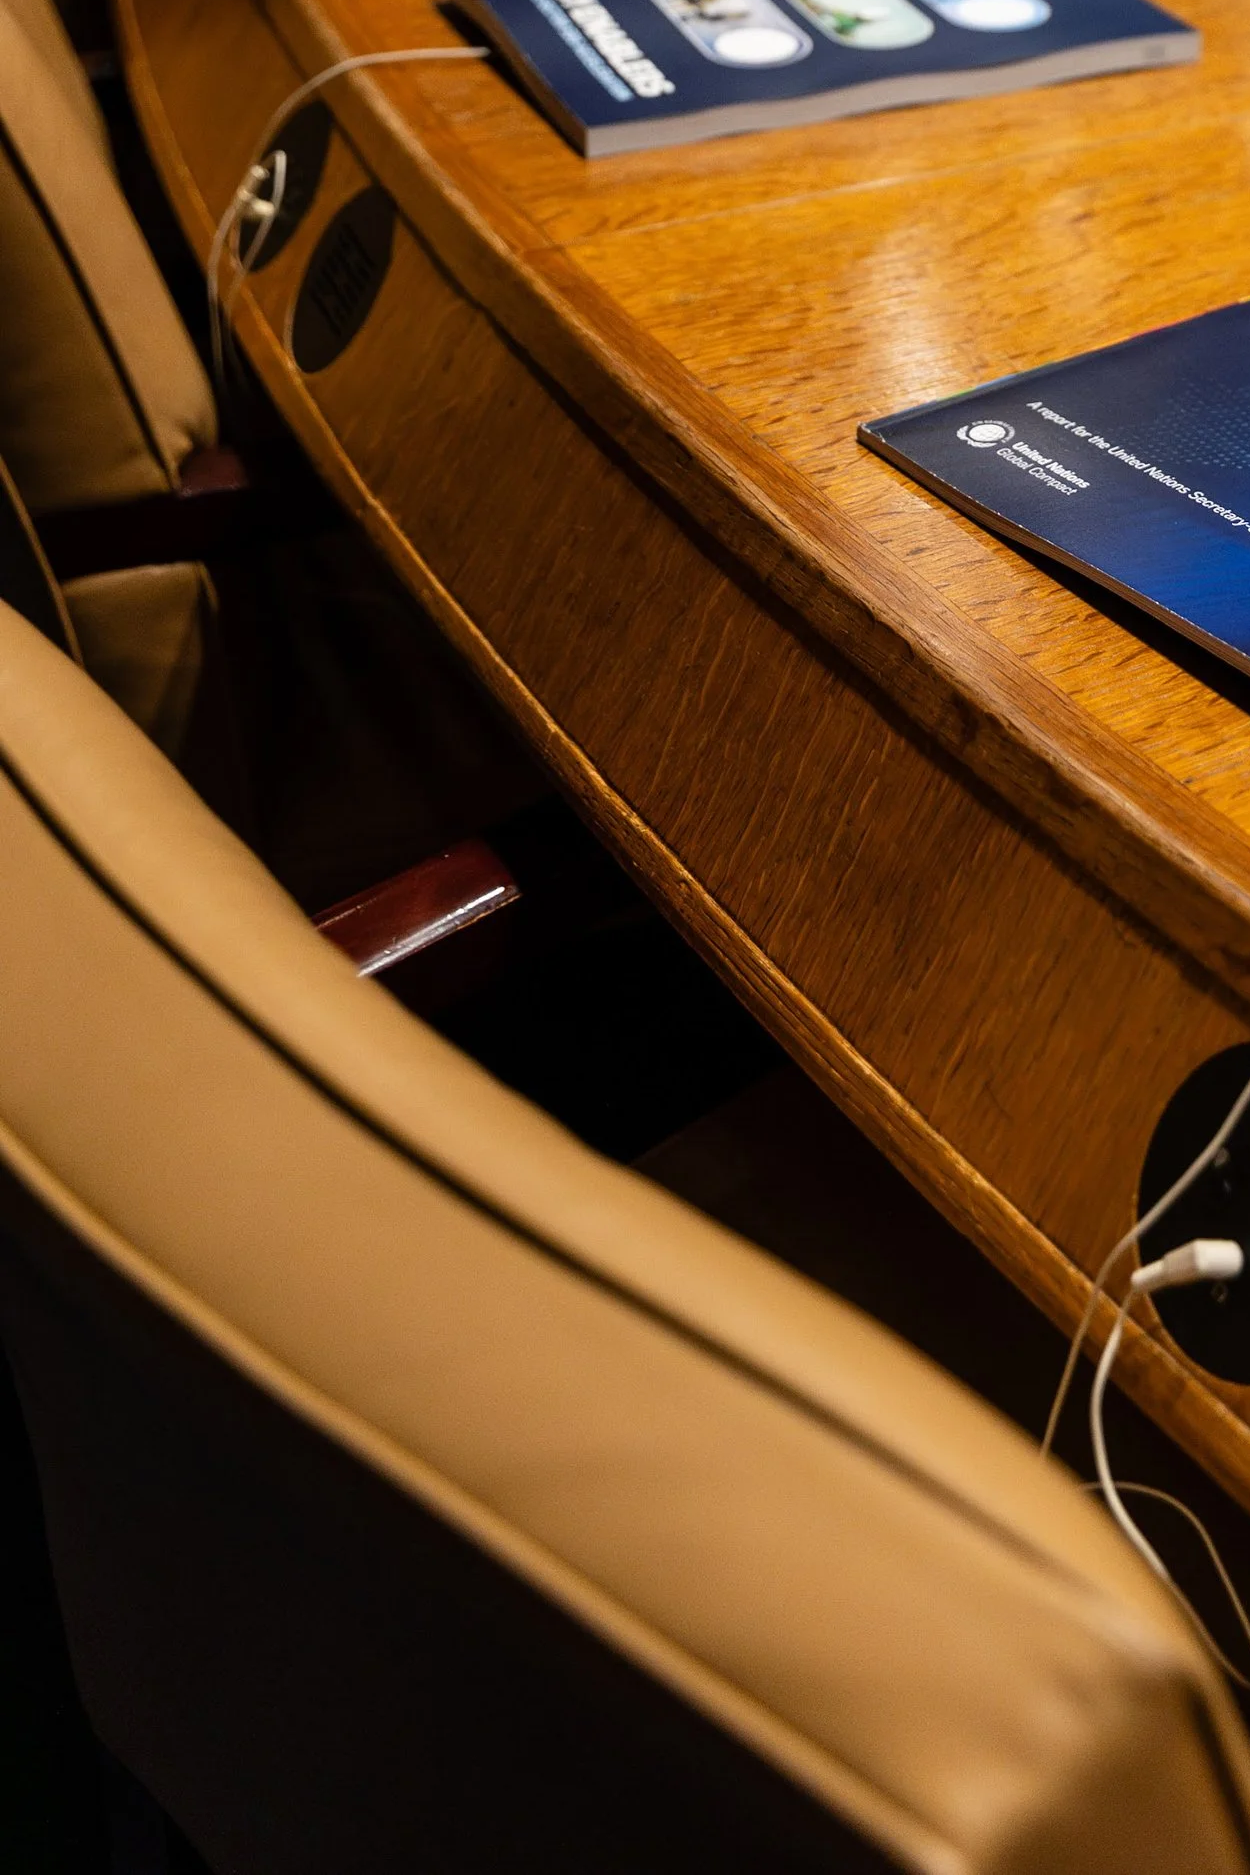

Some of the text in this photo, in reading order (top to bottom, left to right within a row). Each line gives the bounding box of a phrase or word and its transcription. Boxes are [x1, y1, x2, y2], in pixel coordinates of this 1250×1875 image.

[996, 447, 1078, 495] Global Compact
[1012, 441, 1090, 488] United Nations
[1026, 401, 1043, 410] A
[1037, 407, 1076, 429] report
[1071, 426, 1092, 438] for
[1088, 435, 1110, 449] the
[1107, 445, 1151, 470] United
[1143, 466, 1191, 494] Nations
